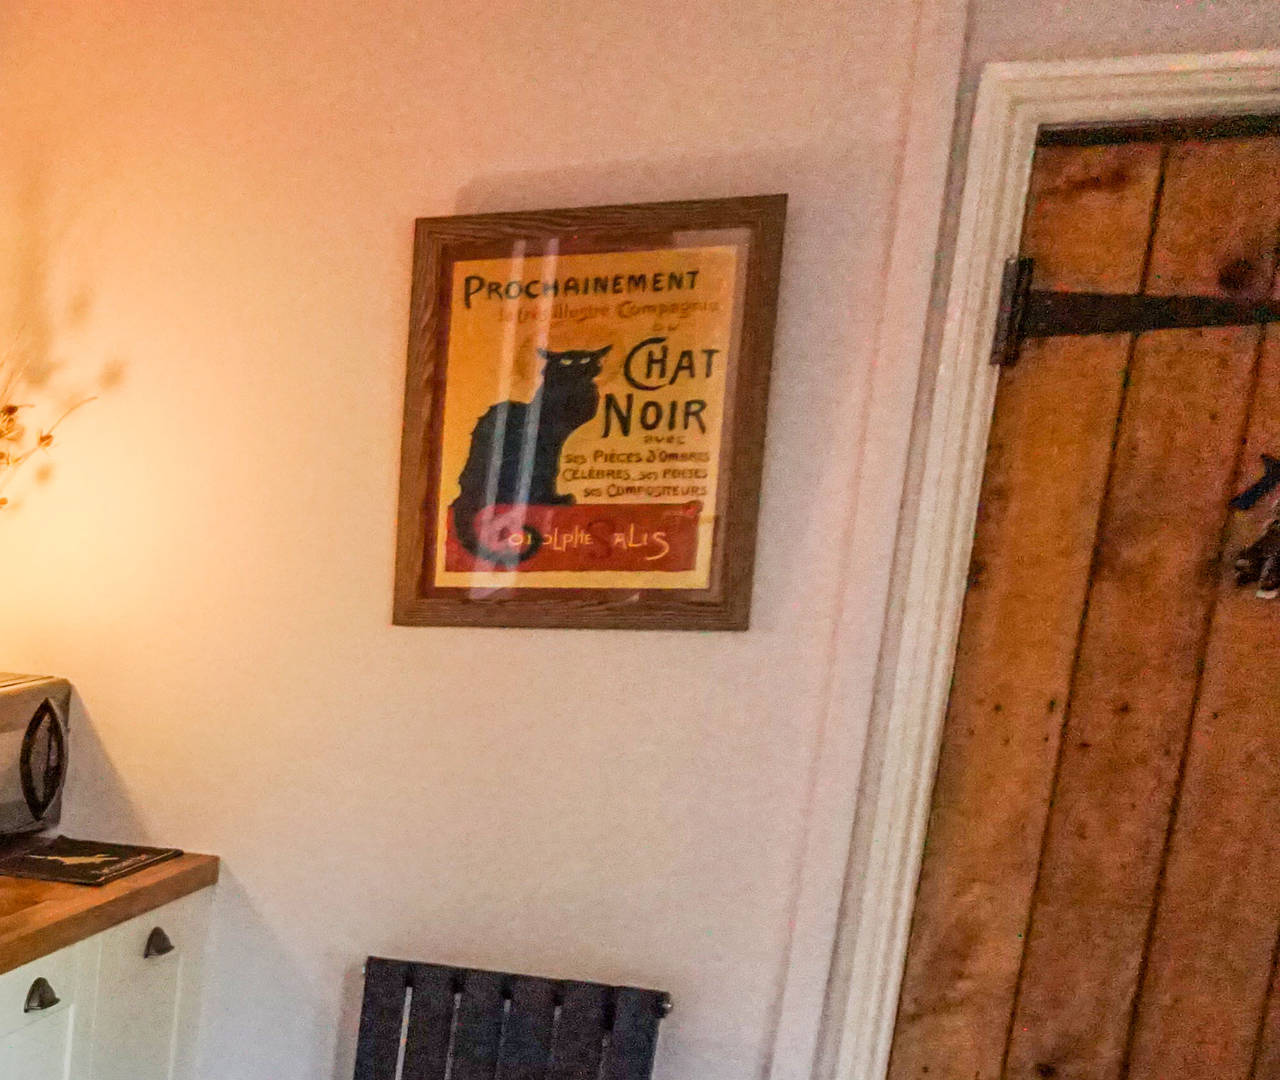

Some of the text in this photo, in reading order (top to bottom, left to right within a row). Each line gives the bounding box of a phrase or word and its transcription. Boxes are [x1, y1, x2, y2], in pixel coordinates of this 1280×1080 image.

[464, 271, 700, 309] PROCHAINEMENT
[624, 337, 720, 391] CHAT
[601, 393, 707, 438] NOIR
